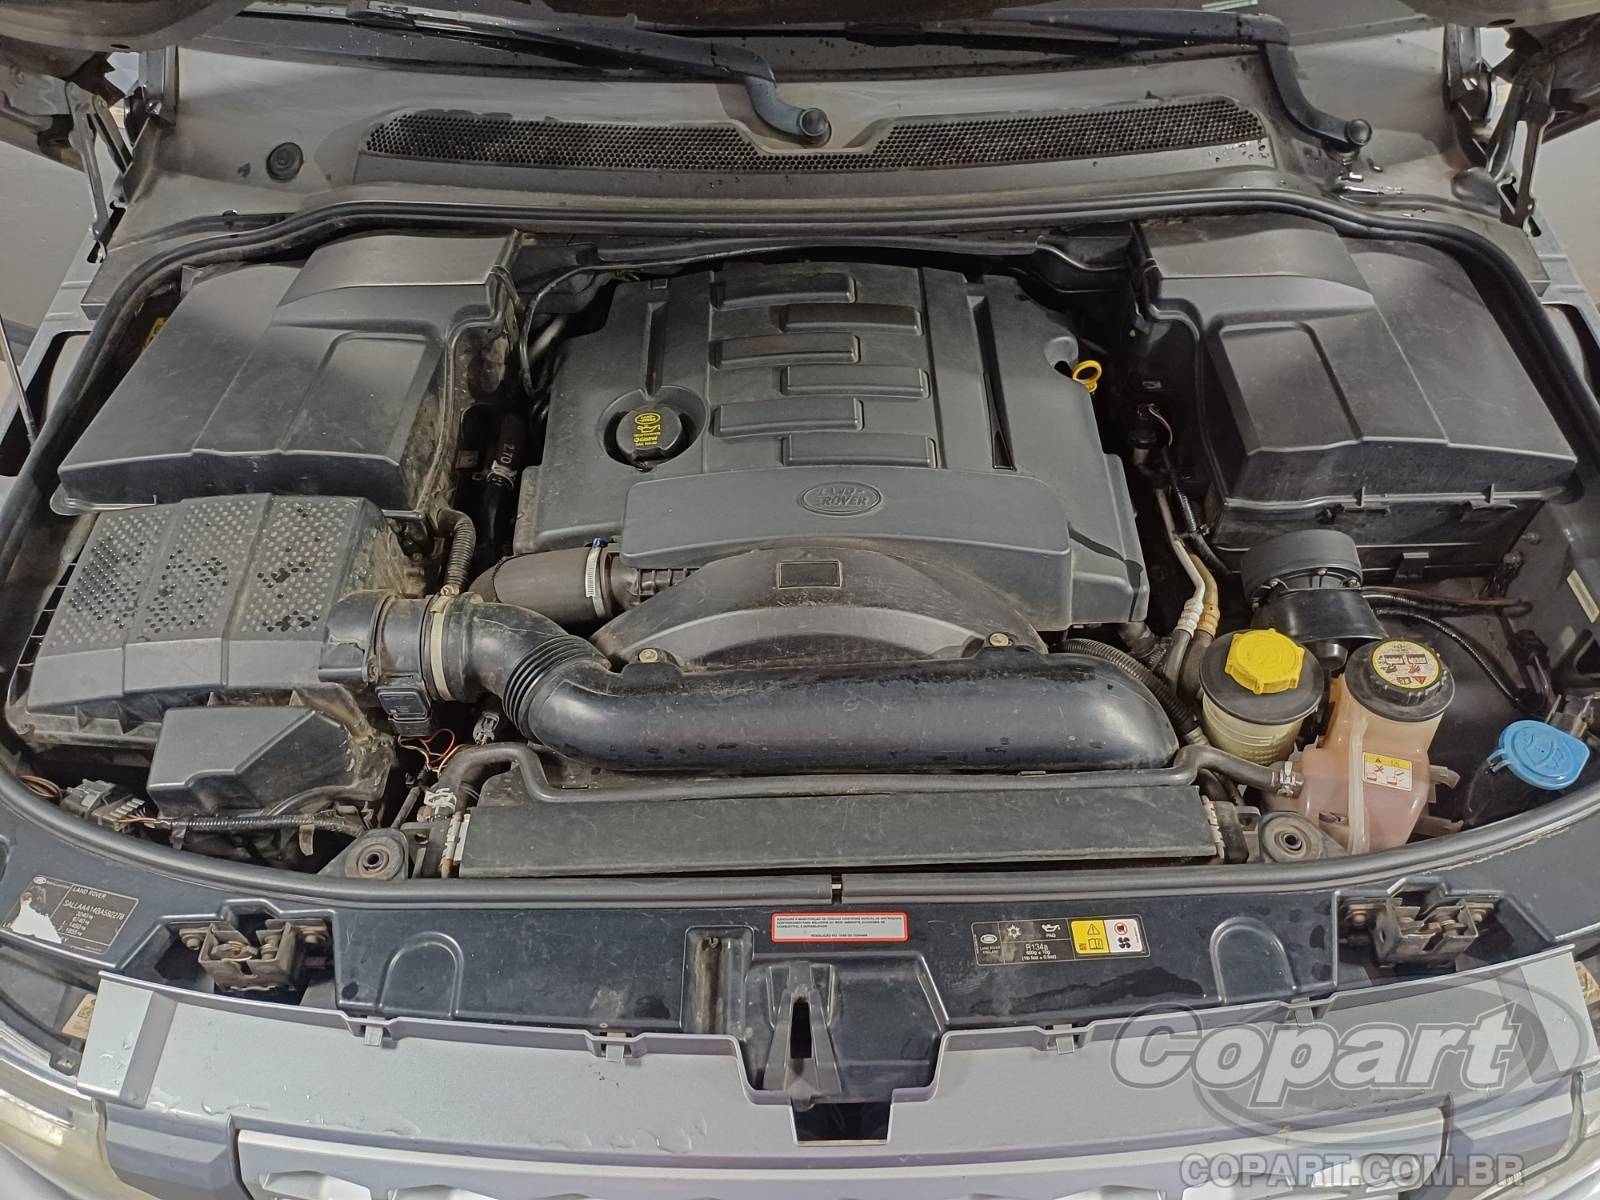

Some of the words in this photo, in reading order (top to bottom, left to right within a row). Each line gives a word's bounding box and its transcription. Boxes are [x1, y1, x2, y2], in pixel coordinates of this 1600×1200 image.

[823, 496, 869, 506] ROVER
[72, 886, 89, 895] LAND
[88, 890, 107, 899] ROVER
[1025, 943, 1049, 951] R134a
